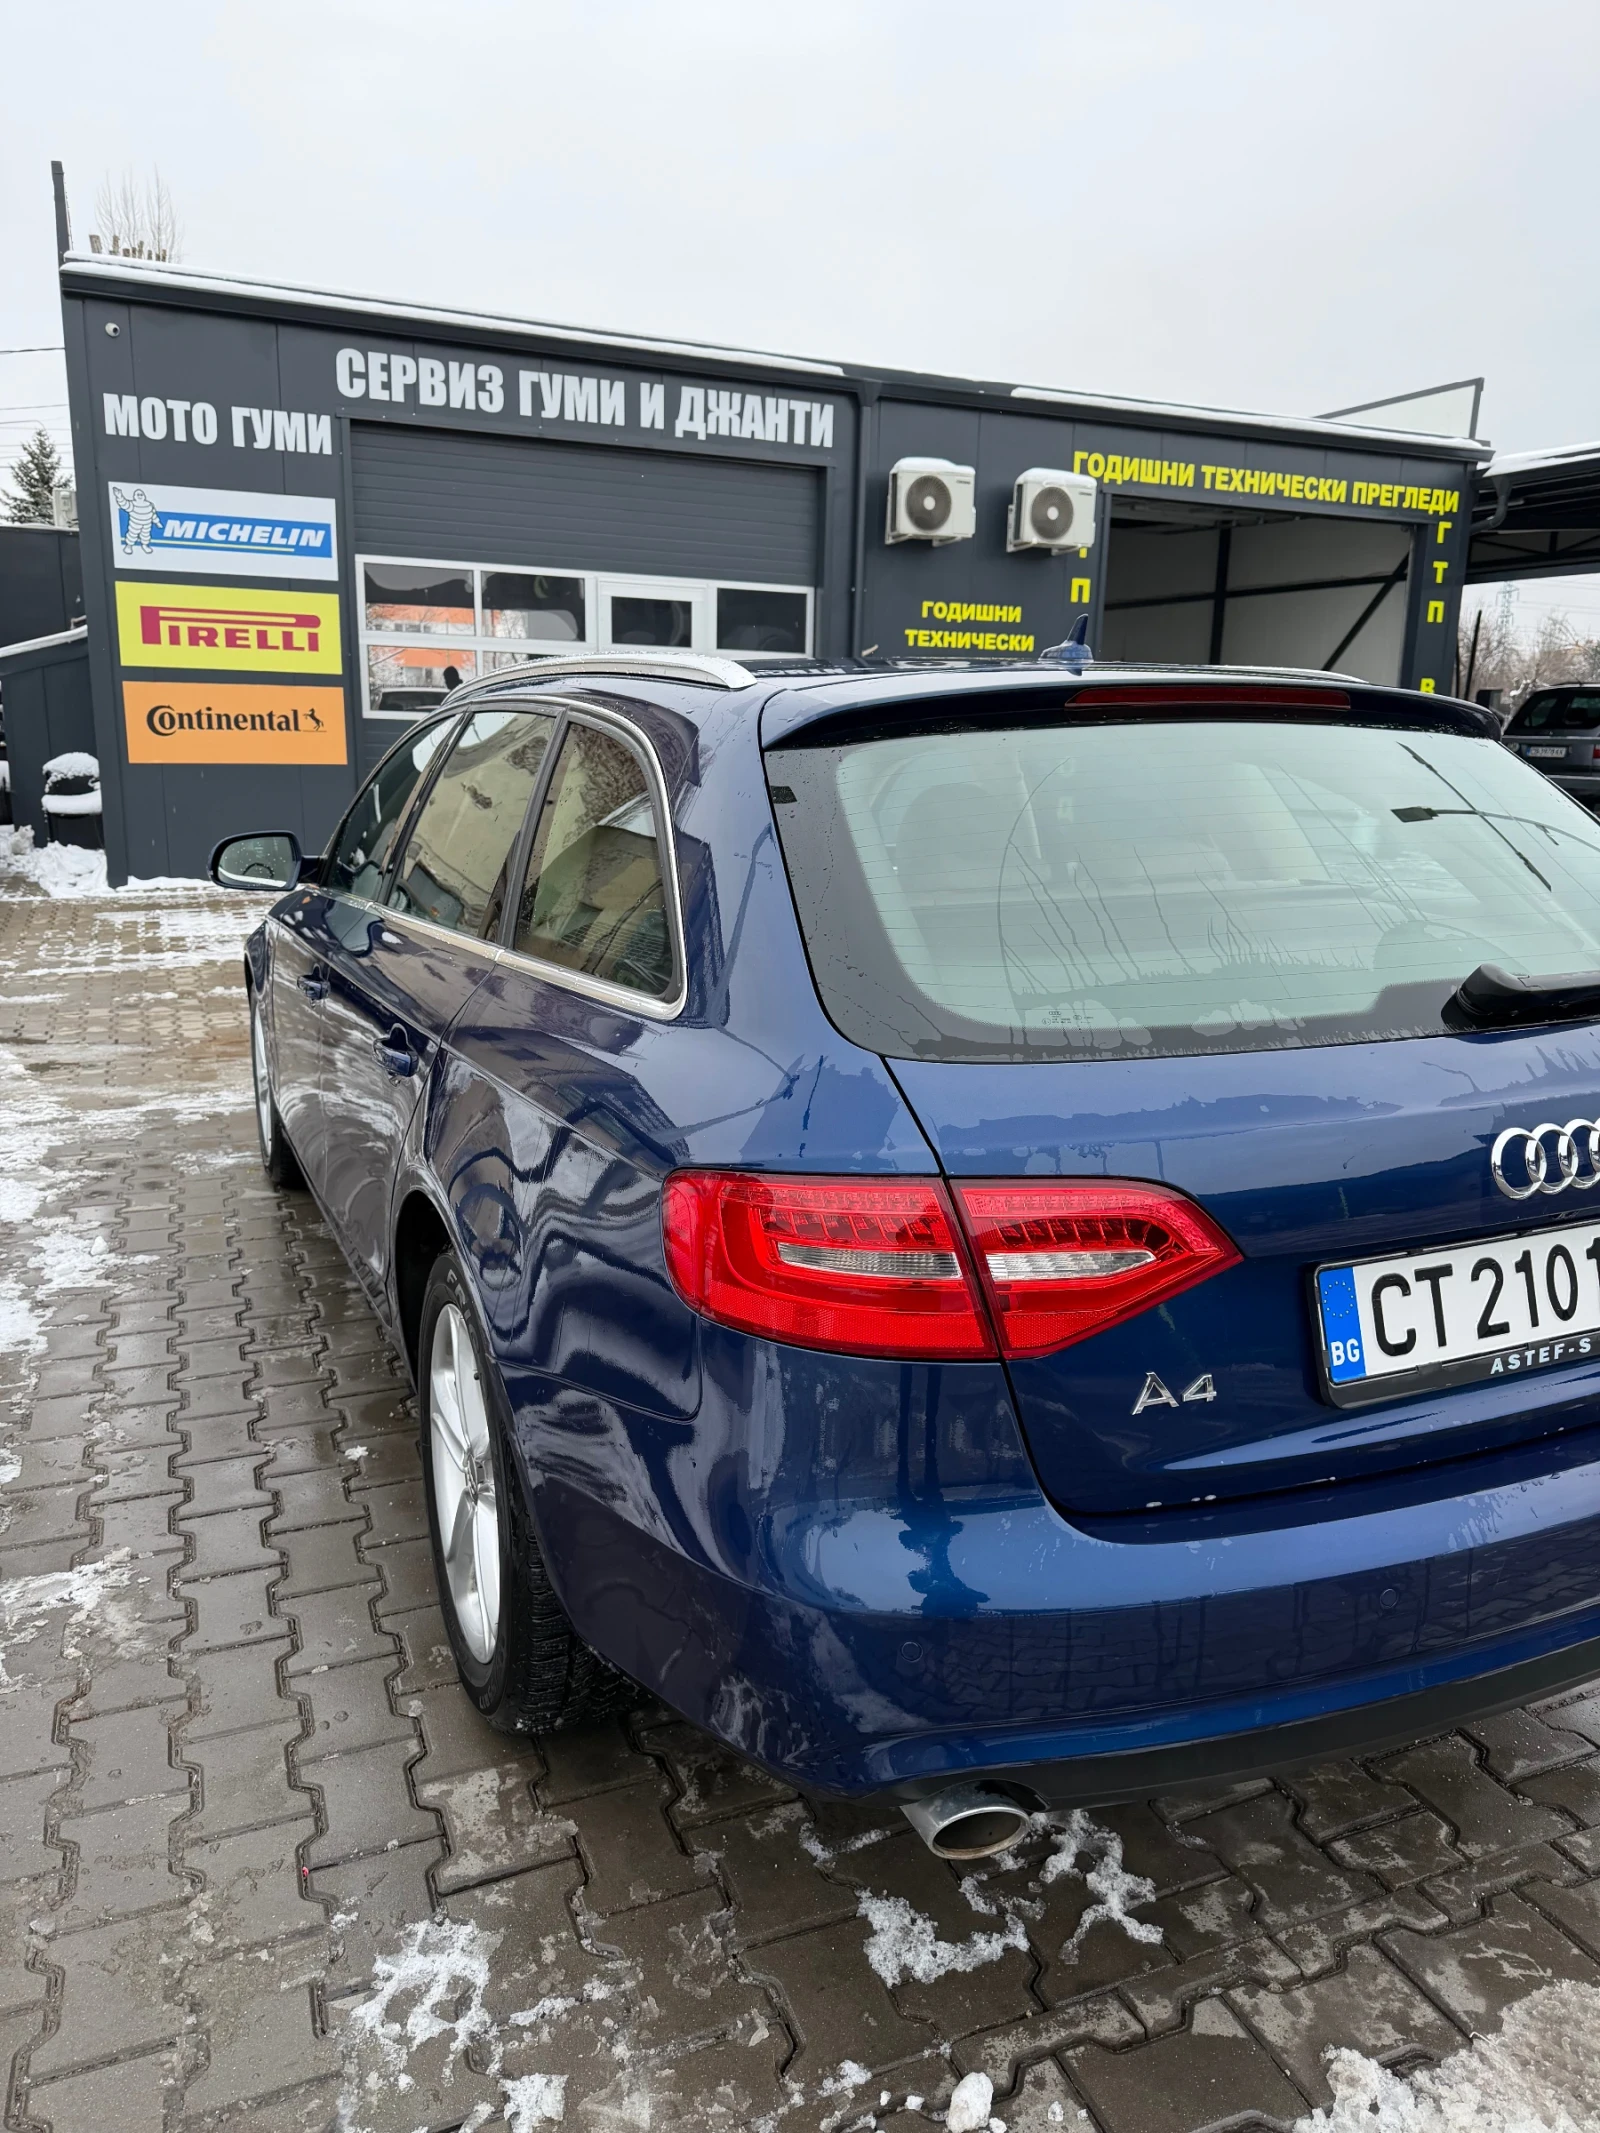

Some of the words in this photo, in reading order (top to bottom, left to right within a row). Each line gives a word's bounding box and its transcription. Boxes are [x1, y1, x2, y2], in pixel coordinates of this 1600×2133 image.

[335, 347, 505, 414] СЕРВИЗ
[518, 369, 626, 427] ГУМИ
[640, 382, 665, 430] И
[674, 385, 834, 448] ДЖАНТИ
[102, 393, 218, 446] МОТО
[231, 405, 333, 456] ГУМИ
[1073, 451, 1196, 487] ГОДИШНИ
[1201, 465, 1347, 504] ТЕХНИЧЕСКИ
[1351, 481, 1460, 516] ПРЕГЛЕДИ
[161, 519, 325, 549] MICHELIN
[139, 605, 322, 653] PIRELLI
[921, 600, 1022, 624] ГОДИШНИ
[904, 629, 1035, 653] ТЕХНИЧЕСКИ
[146, 704, 301, 737] Continental
[1331, 1337, 1360, 1367] BG
[1130, 1371, 1218, 1416] A4
